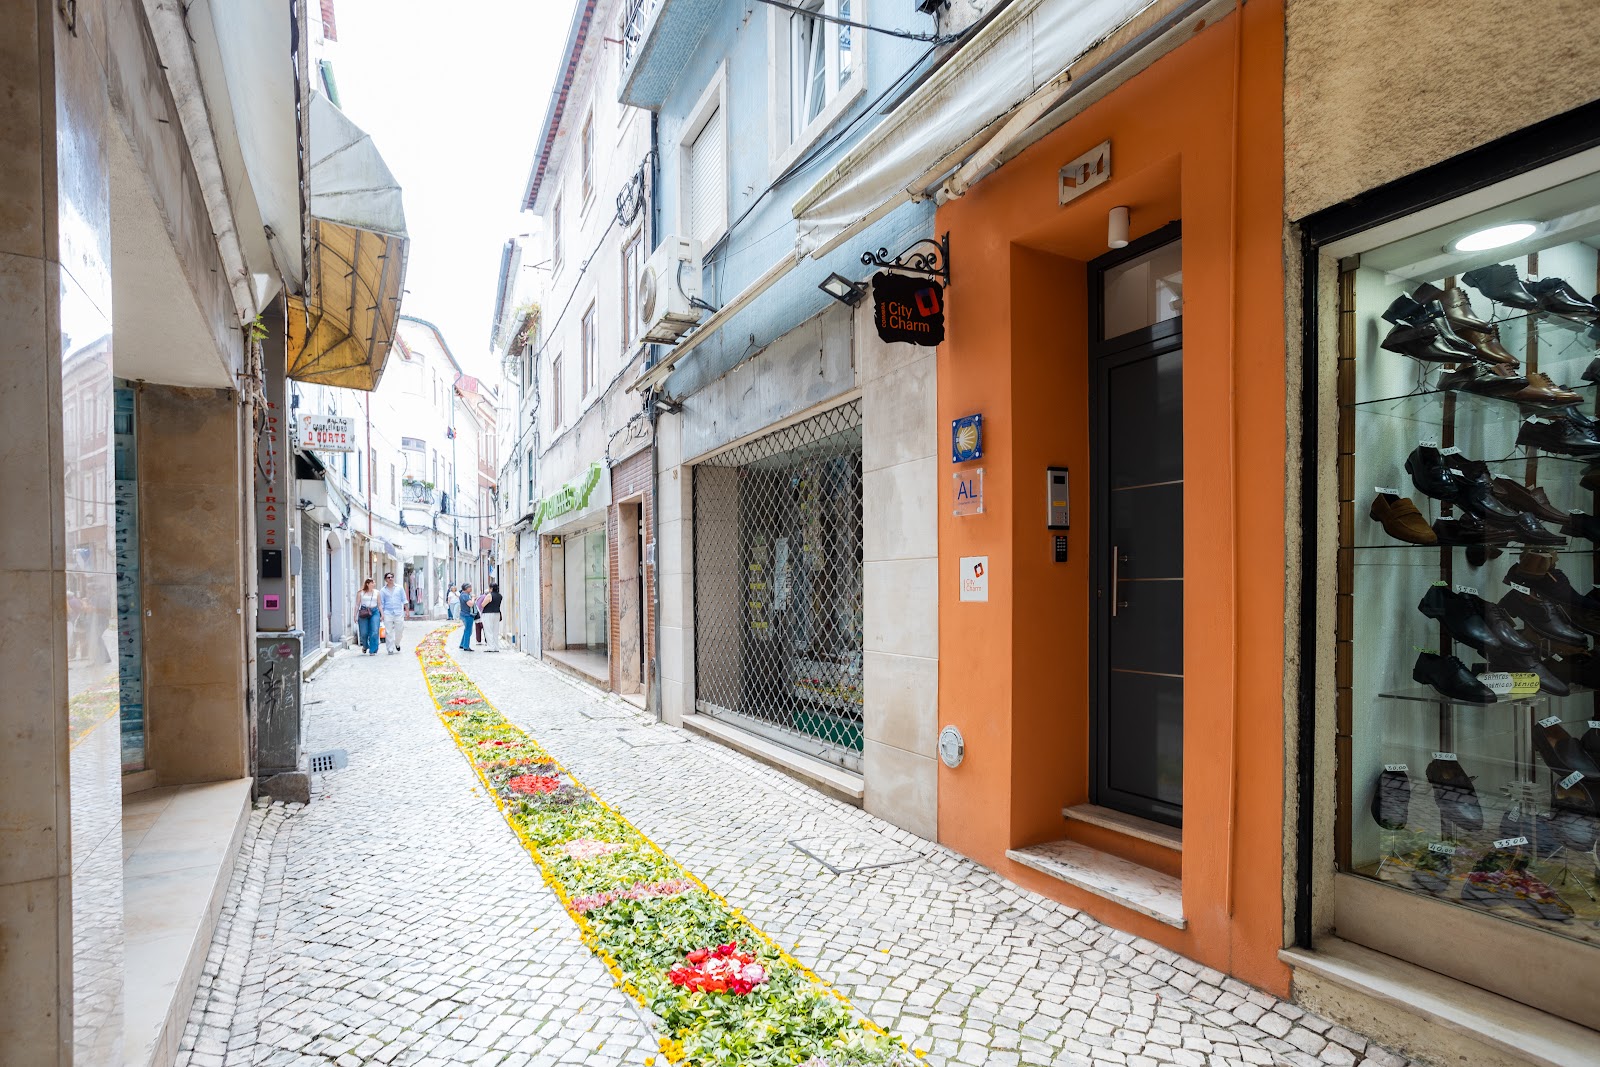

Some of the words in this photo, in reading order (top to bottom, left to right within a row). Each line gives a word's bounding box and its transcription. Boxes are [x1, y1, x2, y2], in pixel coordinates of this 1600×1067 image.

[889, 301, 912, 319] City
[889, 316, 929, 332] Charm
[265, 450, 277, 521] PADIRAS
[957, 480, 977, 500] AL
[266, 529, 276, 545] 25
